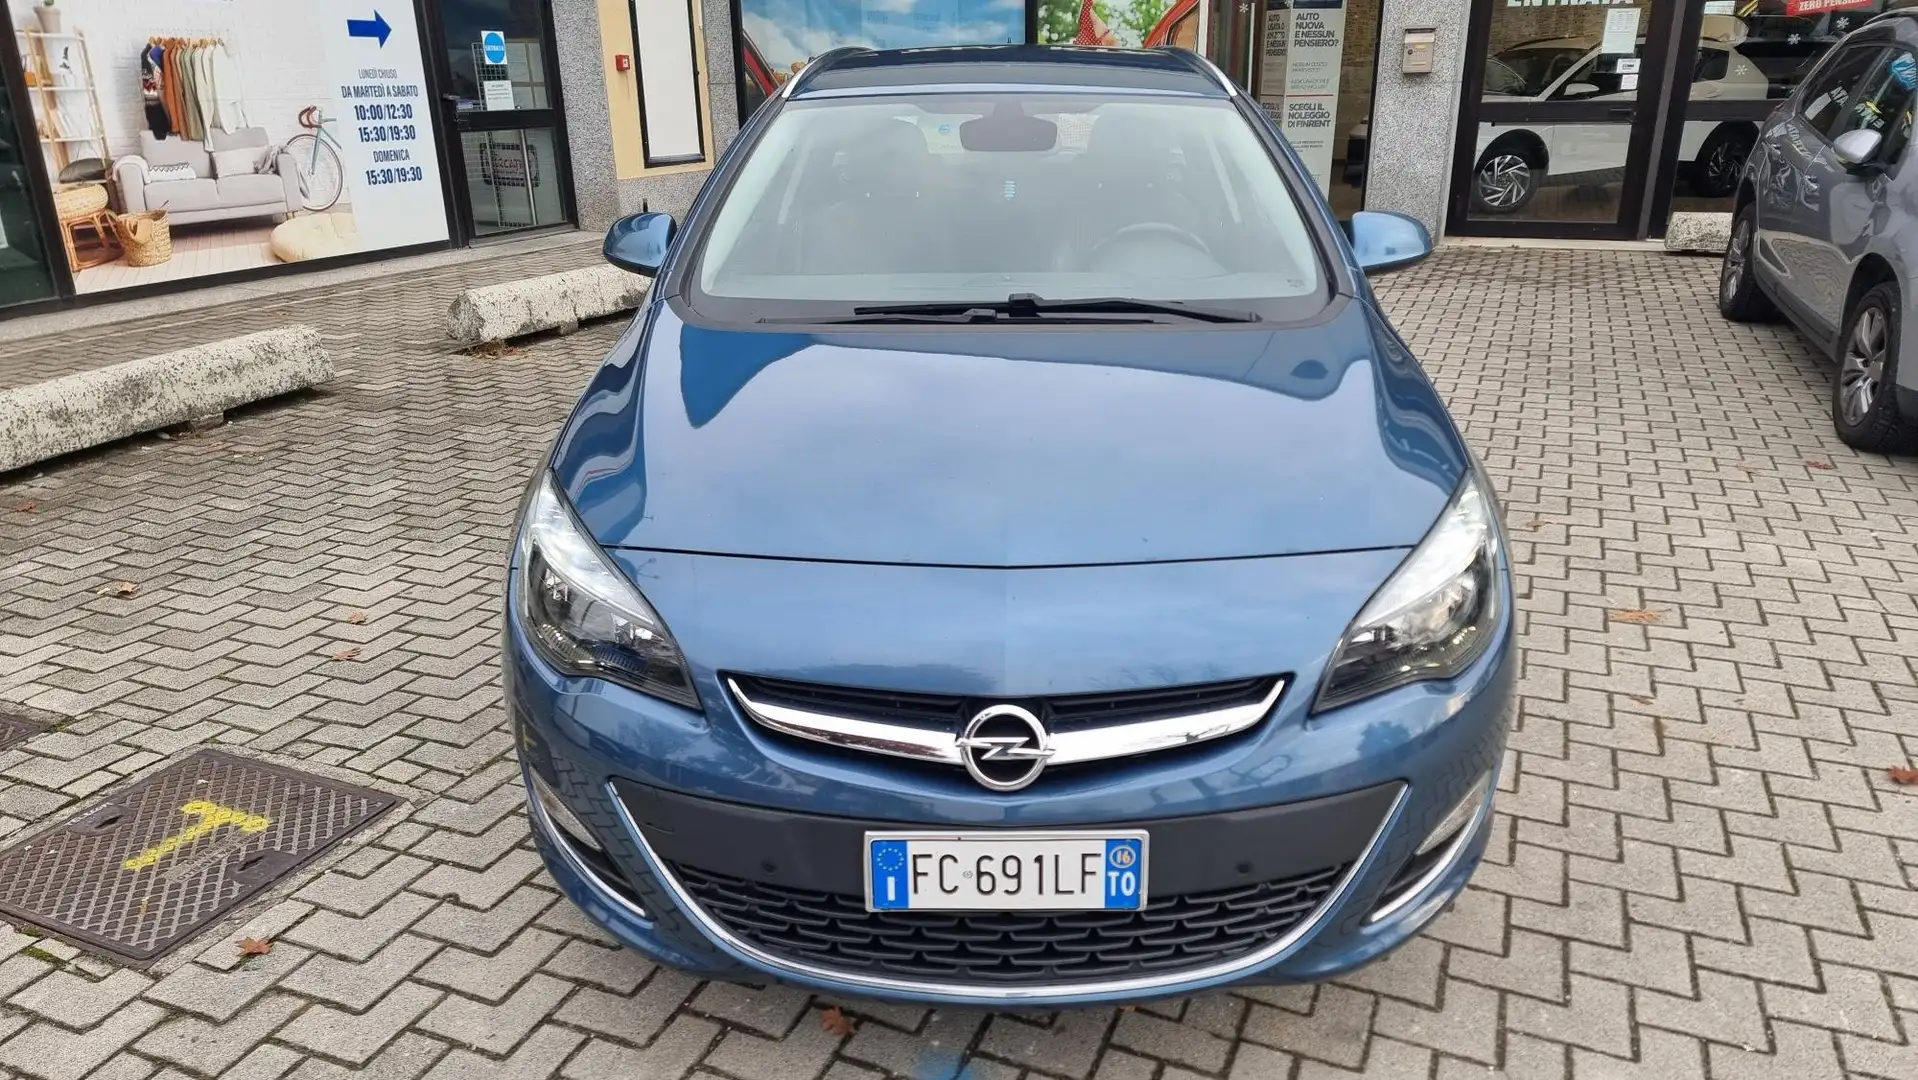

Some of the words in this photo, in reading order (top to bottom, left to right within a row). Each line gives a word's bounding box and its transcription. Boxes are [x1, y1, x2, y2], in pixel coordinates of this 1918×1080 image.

[1296, 12, 1320, 21] AUTO
[1295, 22, 1325, 30] NUOVA
[1294, 30, 1300, 38] E
[1301, 30, 1335, 38] NESSUN
[1293, 39, 1340, 48] PENSIERO?
[358, 68, 378, 80] LUNEDÌ
[378, 68, 398, 79] CHIUSO
[341, 85, 352, 98] DA
[352, 83, 386, 98] MARTEDÌ
[386, 85, 392, 97] A
[392, 85, 418, 98] SABATO
[354, 103, 413, 121] 10:00/12:30
[1288, 103, 1316, 111] SCEGLI
[1317, 103, 1325, 111] IL
[1288, 111, 1331, 120] NOLEGGIO
[1287, 120, 1296, 128] DI
[1296, 120, 1332, 128] FINRENT
[358, 124, 417, 142] 15:30/19:30
[373, 149, 411, 163] DOMENICA
[366, 166, 423, 185] 15:30/19:30
[886, 875, 896, 901] I
[912, 853, 959, 895] FC
[975, 853, 1102, 896] 691LF
[1107, 871, 1136, 897] TO
